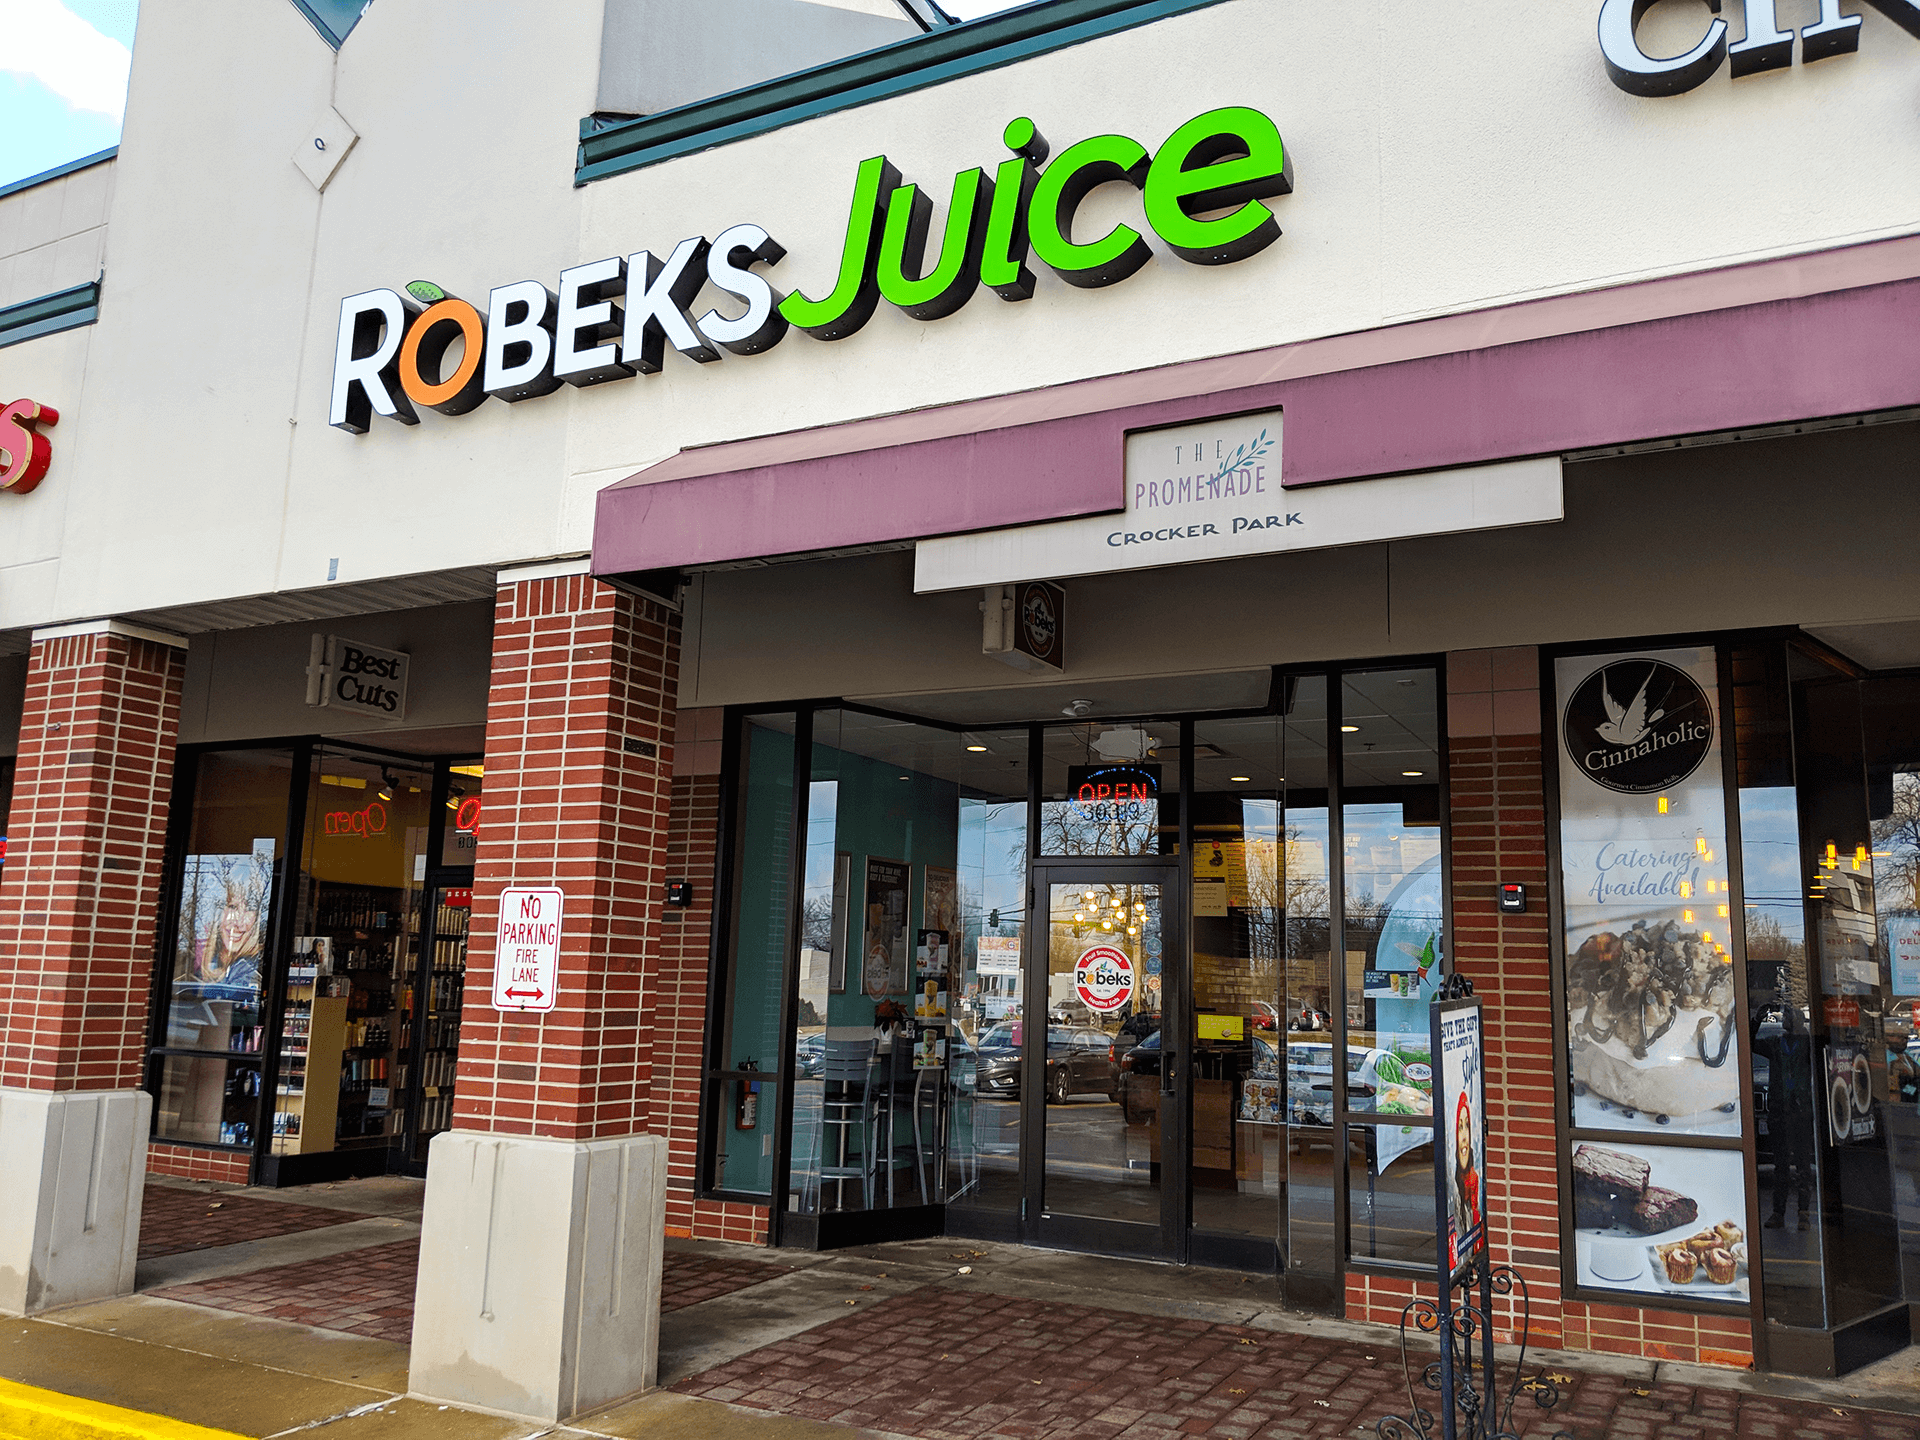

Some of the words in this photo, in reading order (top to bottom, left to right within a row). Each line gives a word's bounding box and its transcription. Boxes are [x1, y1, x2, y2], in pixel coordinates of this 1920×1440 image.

[330, 222, 778, 430] ROBEKS
[778, 106, 1289, 334] Juice
[1175, 440, 1222, 464] THE
[1136, 466, 1266, 509] PROMENADE
[1107, 523, 1220, 546] CROCKER
[1232, 512, 1304, 534] PARK
[340, 646, 400, 680] Best
[337, 675, 399, 712] Cuts
[1585, 721, 1707, 771] Cinnaholic
[1600, 776, 1629, 790] Gourmet
[1629, 782, 1664, 791] Cinnamon
[1663, 774, 1680, 785] Rolls
[1078, 783, 1147, 805] OPEN
[1595, 842, 1691, 875] Catering
[1588, 867, 1700, 904] Availabl!
[520, 898, 541, 919] NO
[503, 923, 555, 945] PARKING
[515, 949, 539, 963] FIRE
[1085, 951, 1097, 962] Fruit
[1096, 950, 1123, 963] Smoothies
[512, 967, 539, 982] LANE
[1077, 970, 1131, 986] Robeks
[1088, 996, 1109, 1007] Healthy
[1108, 997, 1120, 1006] Eats
[1454, 1017, 1465, 1035] THE
[1466, 1015, 1477, 1032] GIFT
